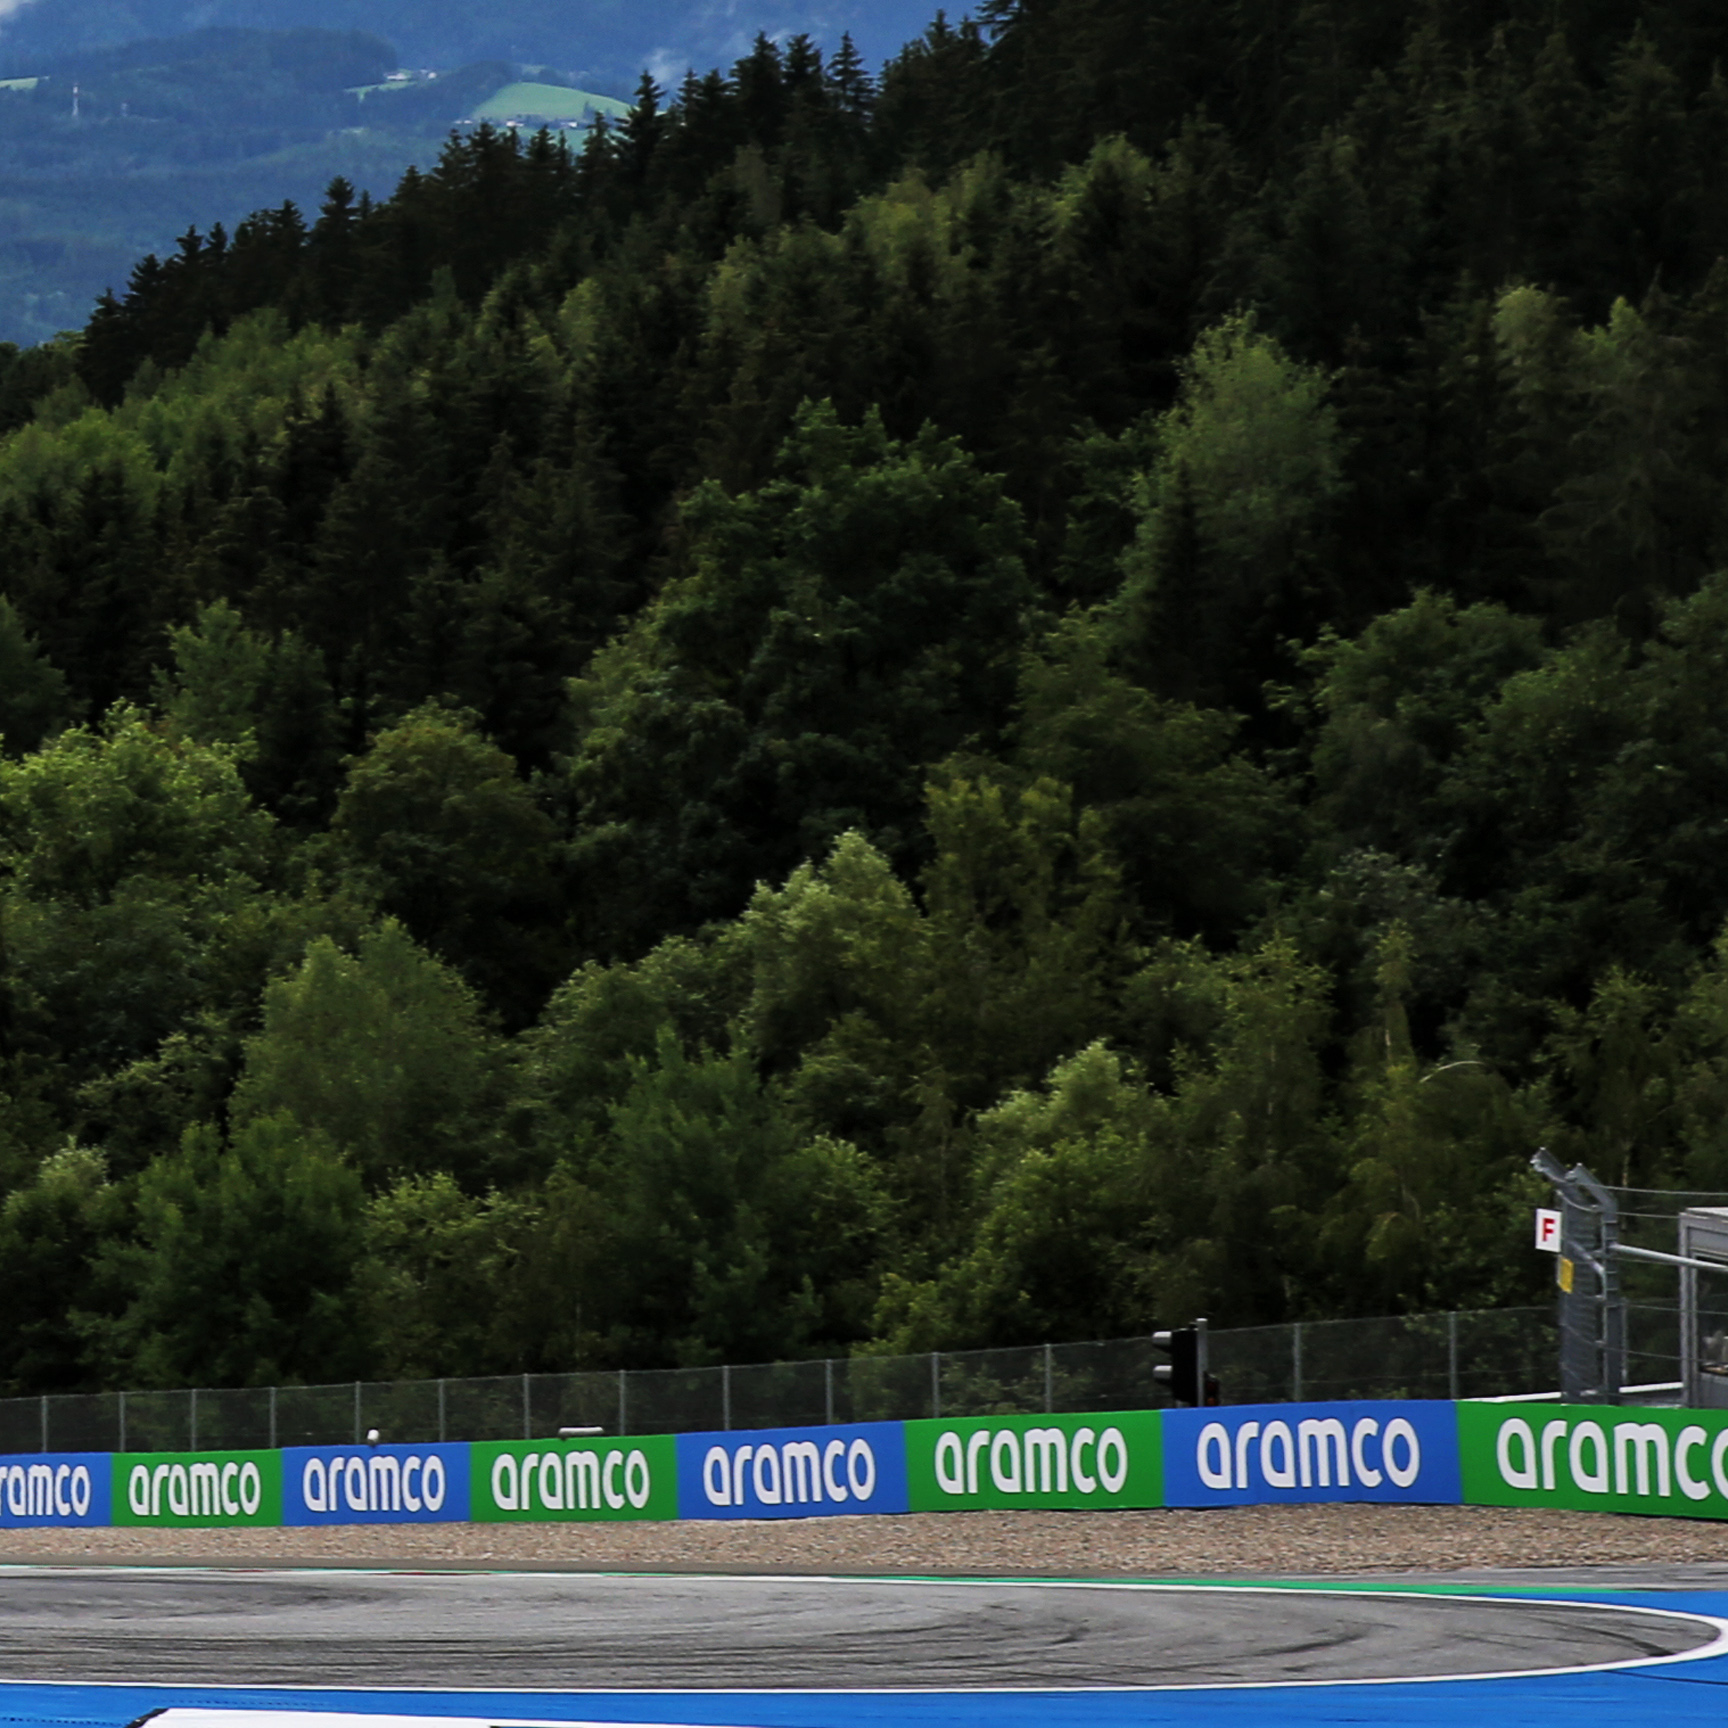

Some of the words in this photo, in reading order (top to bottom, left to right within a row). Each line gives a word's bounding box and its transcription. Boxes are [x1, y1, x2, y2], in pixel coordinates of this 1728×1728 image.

[1542, 1217, 1556, 1242] F
[491, 1450, 650, 1510] aramco
[703, 1438, 876, 1506] aramco
[934, 1427, 1128, 1494] aramco
[1196, 1417, 1421, 1489] aramco
[128, 1462, 261, 1516] aramco
[302, 1455, 445, 1512] aramco
